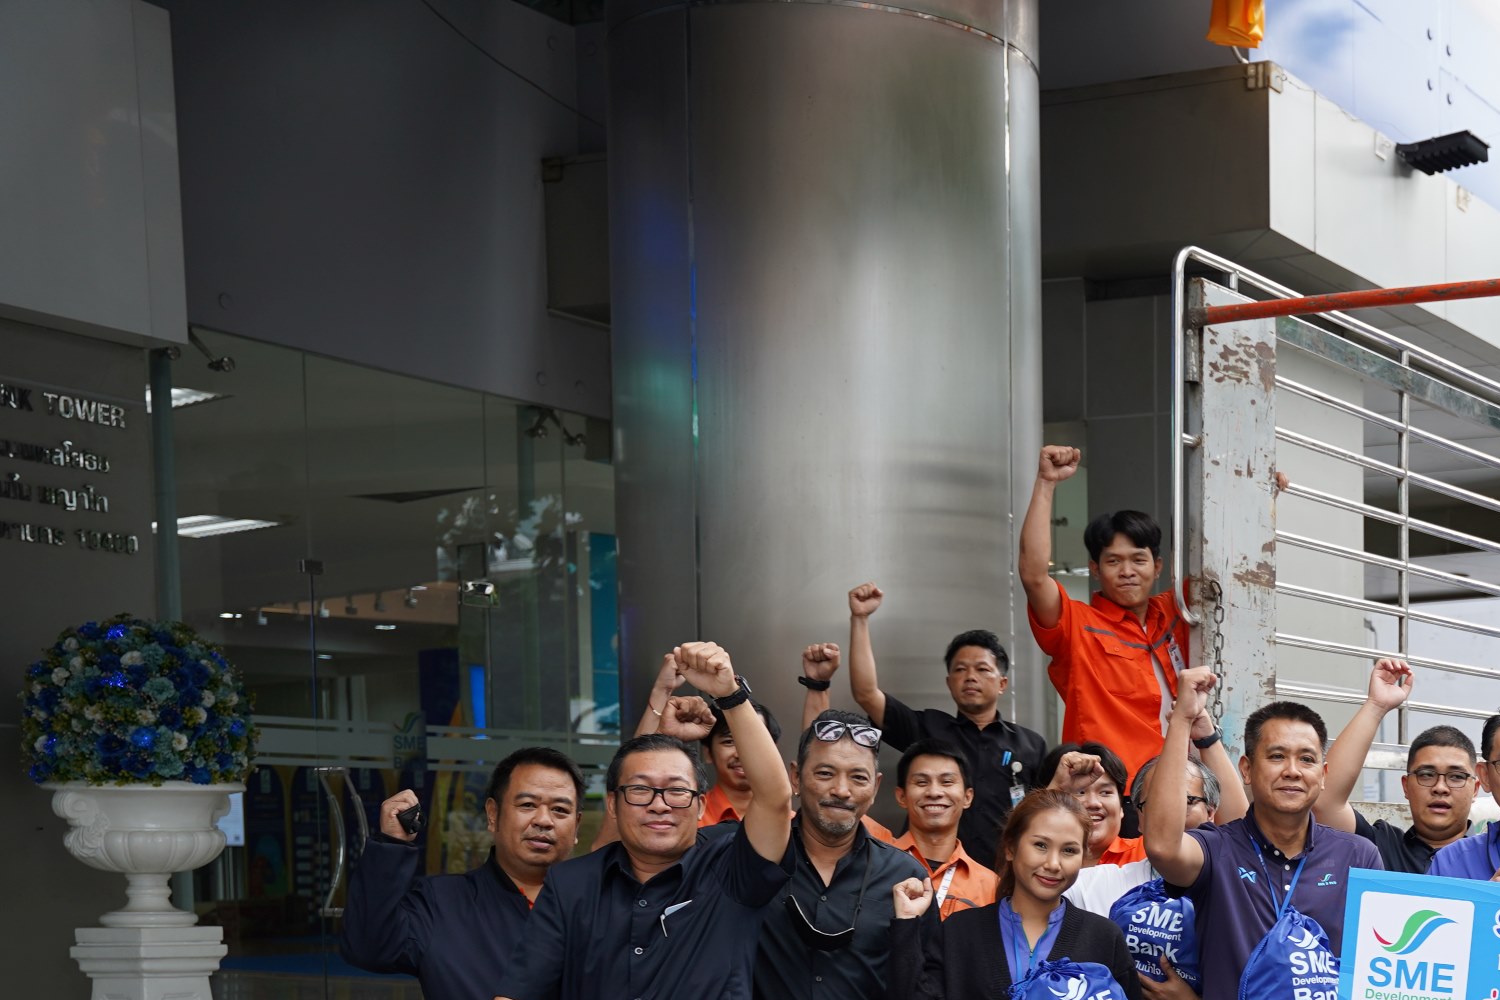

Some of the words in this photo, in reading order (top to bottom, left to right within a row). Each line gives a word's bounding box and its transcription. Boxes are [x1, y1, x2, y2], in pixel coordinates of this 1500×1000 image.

[43, 391, 126, 428] TOWER
[75, 528, 139, 554] 10400
[393, 735, 426, 750] SME
[1131, 905, 1184, 932] SME
[1128, 923, 1182, 942] Development
[1125, 934, 1179, 963] Bank
[1289, 951, 1339, 975] SME
[1367, 956, 1455, 994] SME
